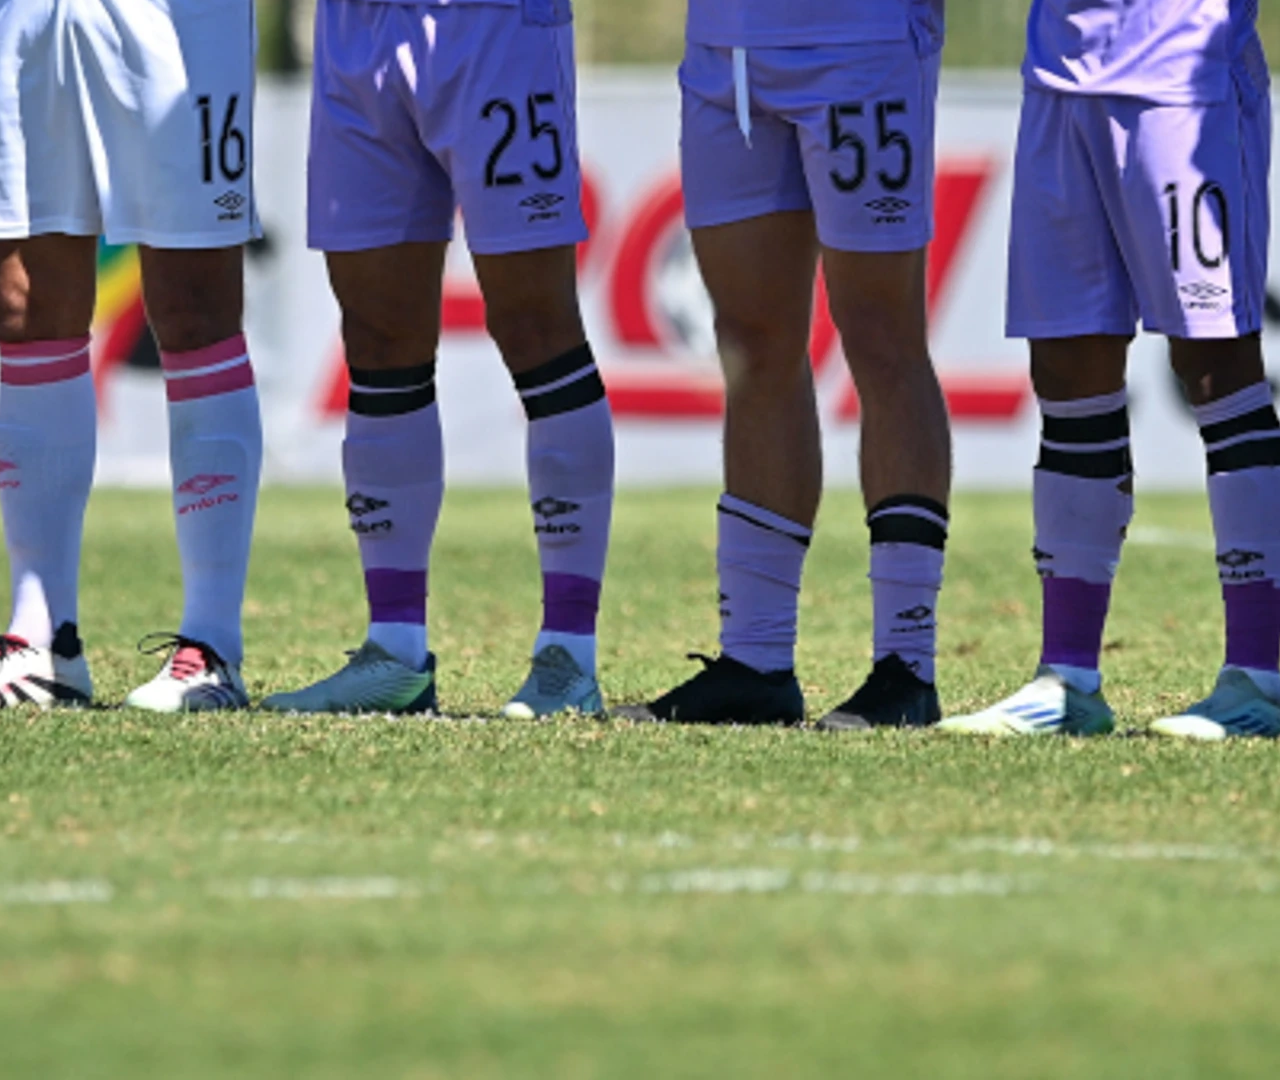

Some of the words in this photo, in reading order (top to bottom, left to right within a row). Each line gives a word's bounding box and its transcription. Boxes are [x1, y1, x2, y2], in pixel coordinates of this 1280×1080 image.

[196, 94, 246, 184] 16
[481, 93, 562, 187] 25
[828, 102, 913, 192] 55
[1164, 180, 1230, 272] 10
